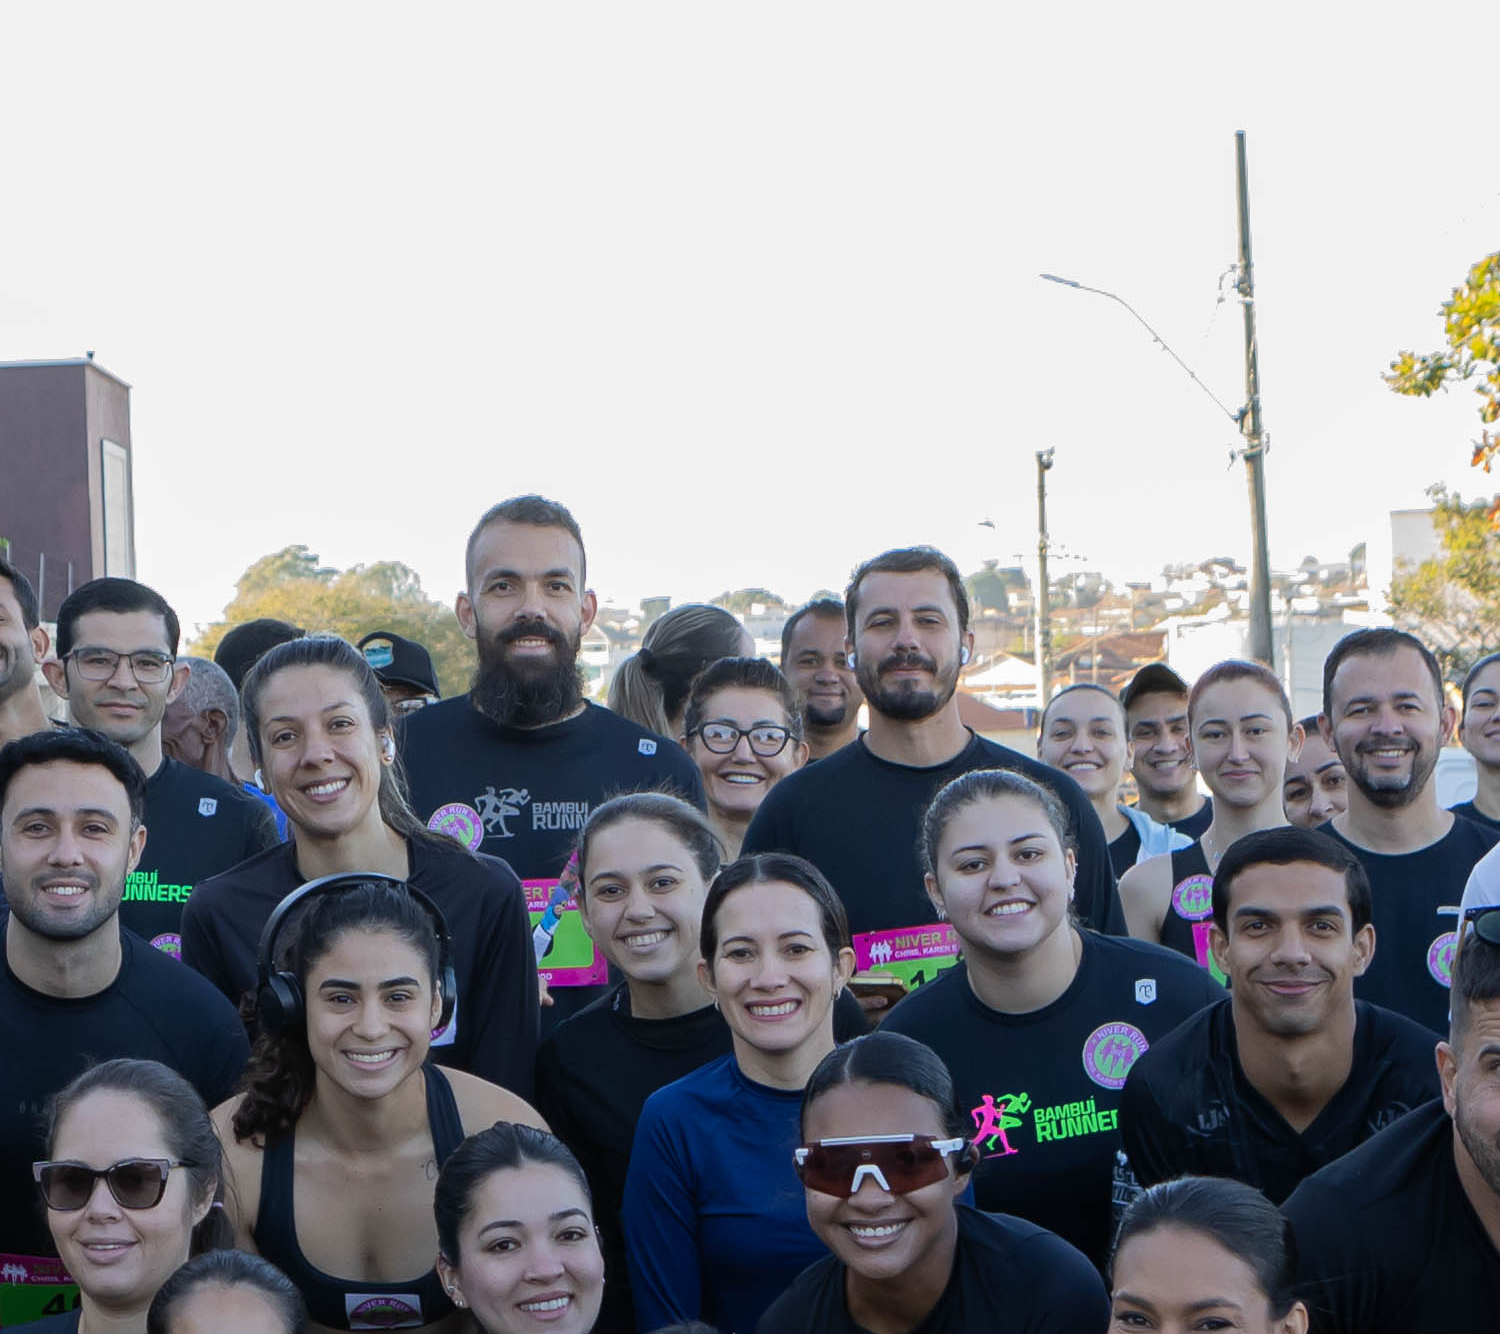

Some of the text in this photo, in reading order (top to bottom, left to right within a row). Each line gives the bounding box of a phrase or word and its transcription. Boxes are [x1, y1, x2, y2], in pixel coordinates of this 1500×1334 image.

[532, 813, 590, 831] RUNN
[125, 869, 159, 885] MBUÍ
[122, 884, 193, 903] UNNERS
[895, 932, 943, 948] NIVER
[1034, 1095, 1096, 1124] BAMBUÍ
[1036, 1109, 1118, 1144] RUNNE
